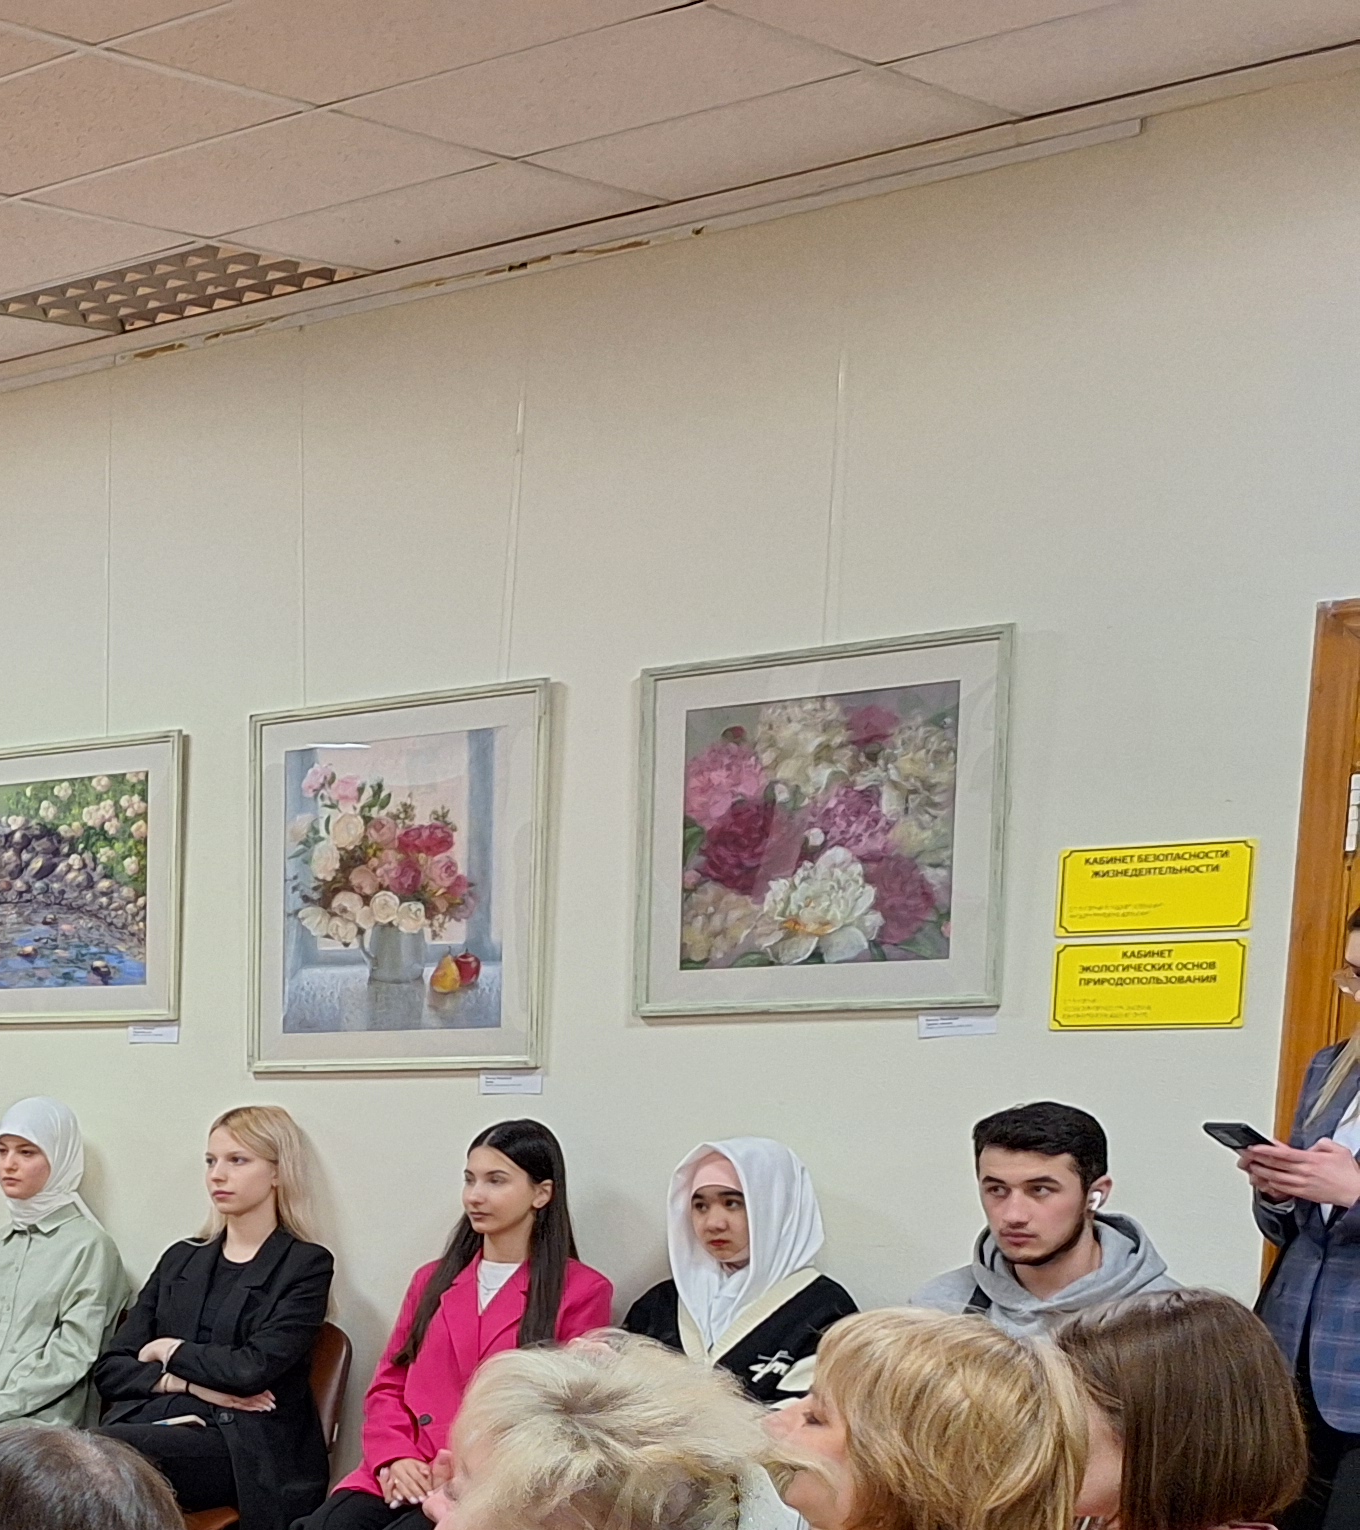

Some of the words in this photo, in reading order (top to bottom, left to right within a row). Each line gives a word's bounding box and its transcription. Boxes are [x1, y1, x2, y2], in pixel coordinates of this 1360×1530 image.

[1084, 855, 1136, 866] КАБИНЕТ
[1137, 850, 1230, 863] БЕЗОПАСНОСТИ
[1091, 864, 1220, 878] ЖИЗНЕДЕЯТЕЛЬНОСТИ
[1121, 949, 1174, 959] КАБИНЕТ
[1079, 962, 1173, 974] ЭКОЛОГИЧЕСКИХ
[1175, 961, 1217, 971] ОСНОВ
[1079, 975, 1218, 987] ПРИРОДОПОЛЬЗОВАНИЯ
